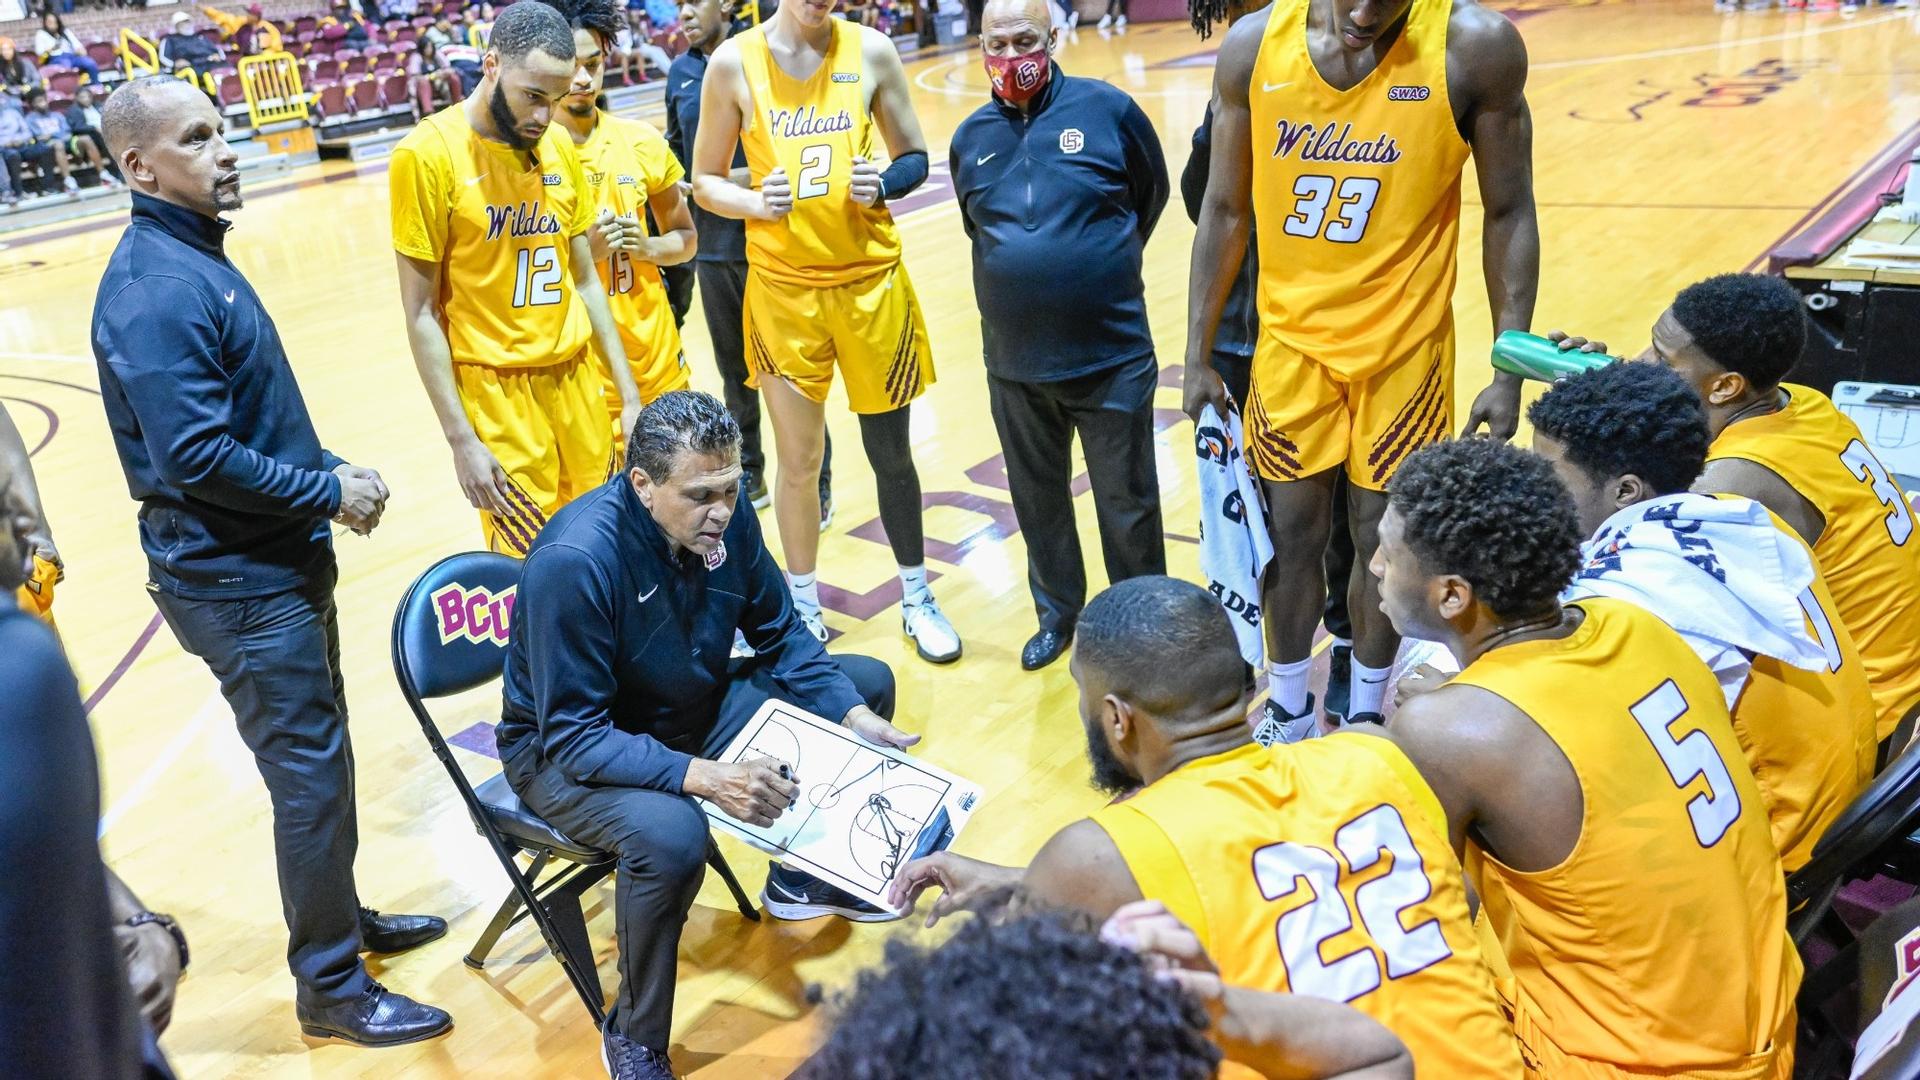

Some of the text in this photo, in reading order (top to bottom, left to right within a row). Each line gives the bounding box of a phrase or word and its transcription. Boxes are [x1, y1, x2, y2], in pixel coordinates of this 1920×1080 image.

[768, 105, 854, 138] Wildcats
[1388, 86, 1430, 100] SWAC
[798, 143, 832, 200] 2
[1272, 119, 1401, 164] Wildcats
[1283, 174, 1381, 244] 33
[511, 245, 563, 308] 12
[608, 250, 634, 296] 15
[1839, 438, 1914, 547] 3
[433, 583, 517, 646] BCU
[1628, 679, 1742, 848] 5
[1251, 803, 1454, 1003] 22
